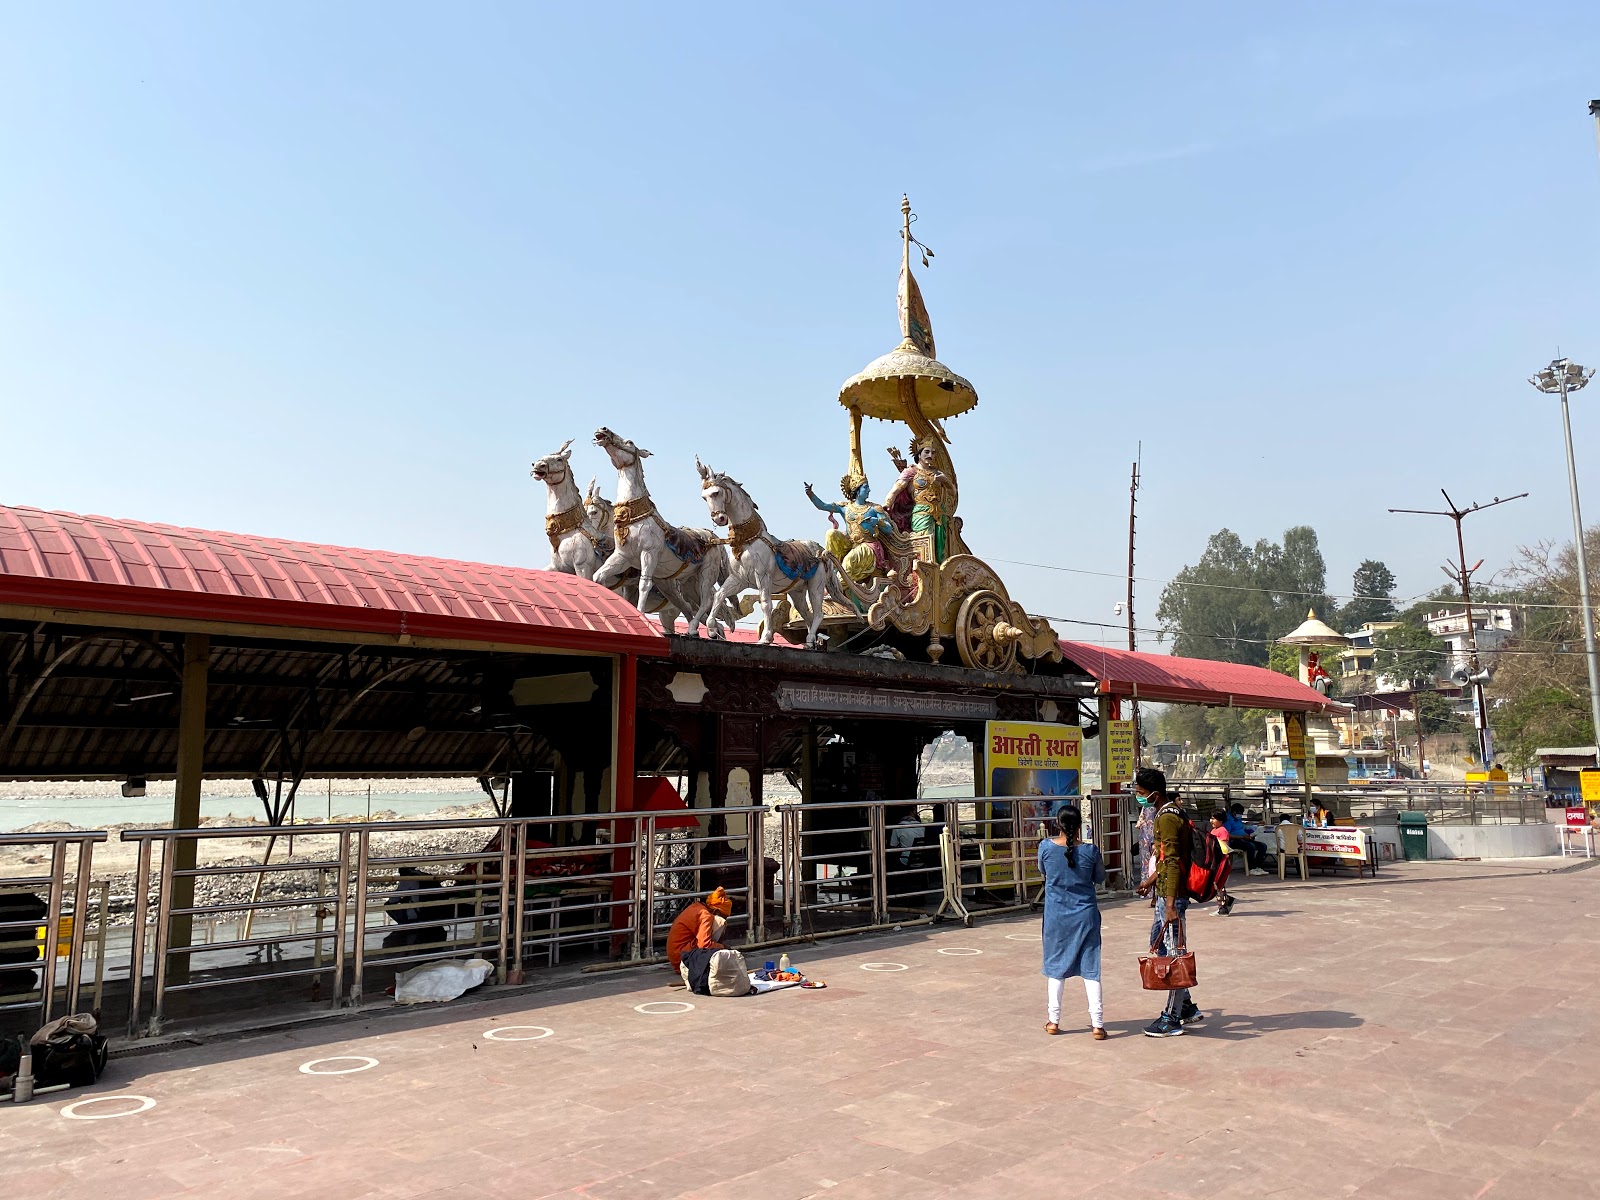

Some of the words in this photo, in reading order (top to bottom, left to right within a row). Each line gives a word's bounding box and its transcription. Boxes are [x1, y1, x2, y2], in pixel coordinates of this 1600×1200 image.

[796, 688, 810, 703] यदा
[811, 685, 818, 704] हि
[992, 733, 1042, 756] आरती
[1046, 739, 1079, 756] स्थल
[1018, 756, 1033, 767] त्रिवेणी
[1034, 759, 1043, 767] घाट
[1044, 757, 1059, 768] परिसर
